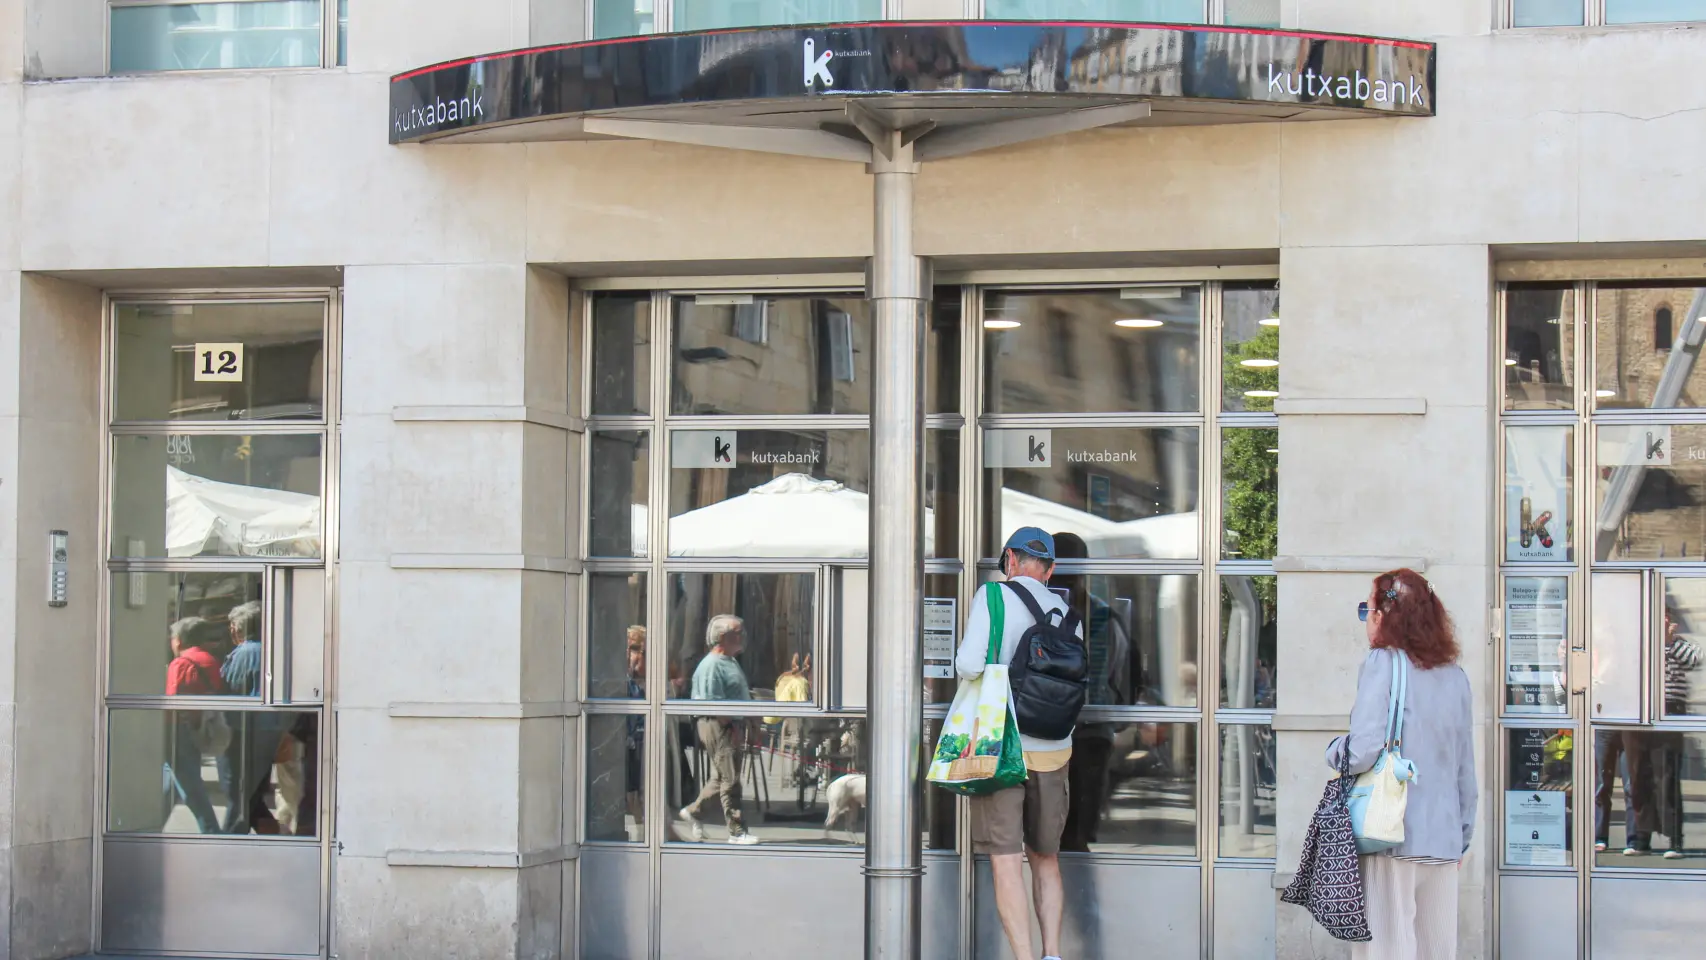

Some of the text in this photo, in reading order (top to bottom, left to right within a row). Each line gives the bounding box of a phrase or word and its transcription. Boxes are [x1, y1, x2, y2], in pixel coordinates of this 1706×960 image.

[834, 49, 872, 57] kutxabank
[1267, 63, 1425, 106] kutxabank
[394, 88, 484, 133] kutxabank
[201, 350, 238, 375] 12
[751, 450, 820, 464] kutxabank
[1067, 449, 1137, 462] kutxabank
